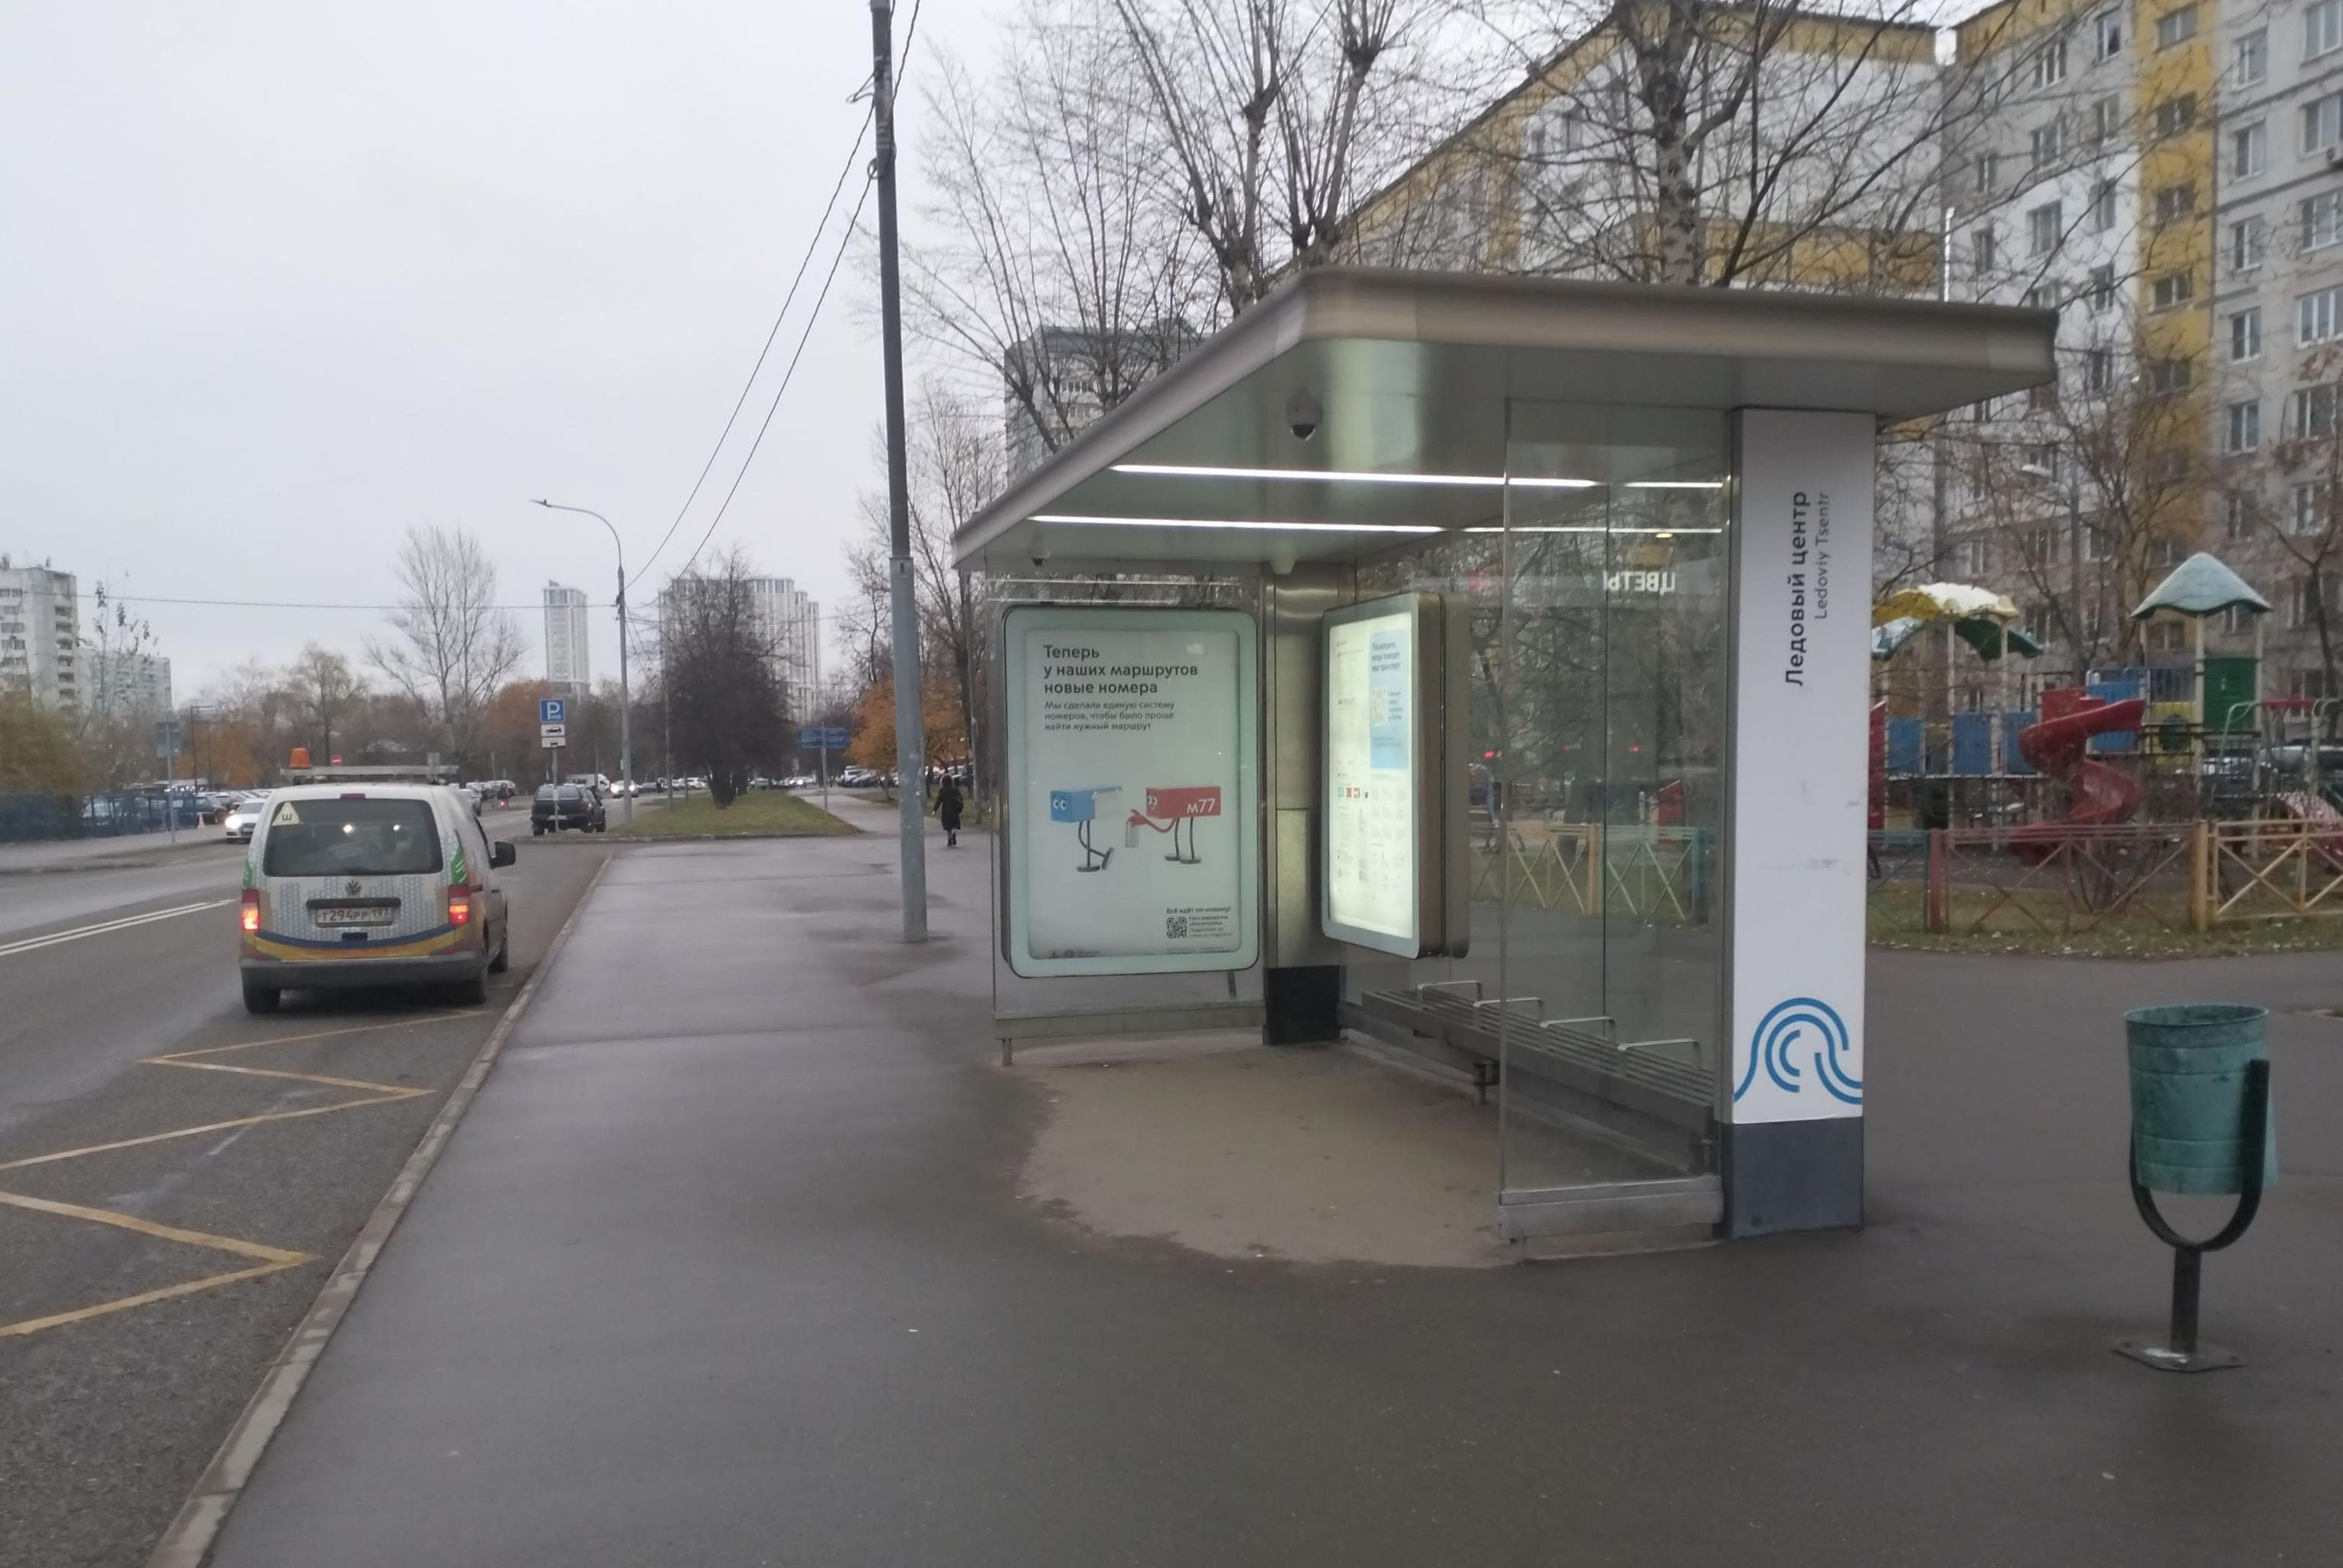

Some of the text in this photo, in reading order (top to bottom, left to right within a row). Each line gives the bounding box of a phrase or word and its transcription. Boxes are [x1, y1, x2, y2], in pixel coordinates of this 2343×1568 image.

[1815, 492, 1831, 619] Ledoviy Tsentr
[1785, 492, 1811, 687] Ледовый центр
[1043, 645, 1100, 662] Теперь
[1044, 665, 1198, 679] у наших маршрутов
[1044, 683, 1158, 696] новые номера
[1064, 701, 1101, 710] сделали
[1103, 701, 1137, 711] единую
[1139, 701, 1175, 711] систему
[1044, 710, 1174, 721] номеров, чтобы было проще
[1044, 721, 1152, 732] найти нужный маршрут
